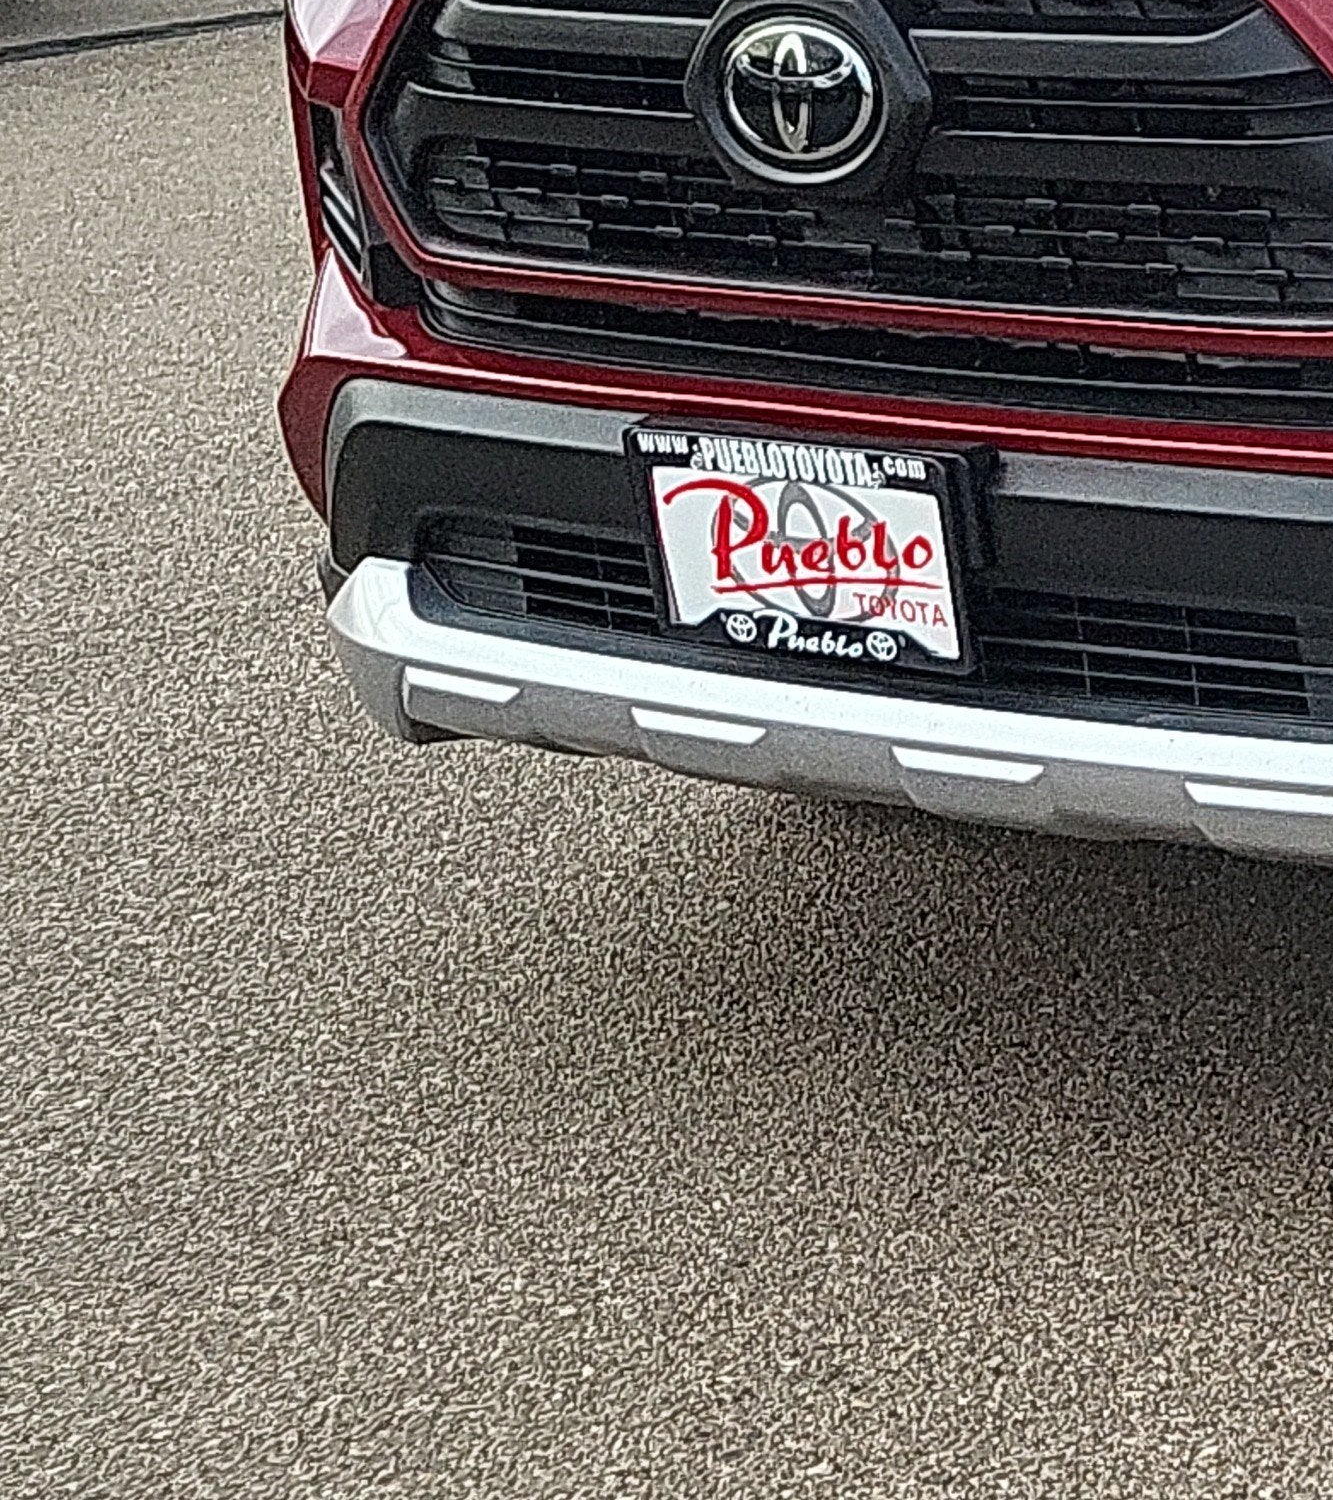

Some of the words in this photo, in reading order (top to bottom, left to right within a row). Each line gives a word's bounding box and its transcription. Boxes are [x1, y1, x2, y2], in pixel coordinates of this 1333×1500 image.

[663, 478, 934, 581] Pueblo
[753, 609, 863, 658] Pueblo
[852, 592, 949, 628] TOYOTA
